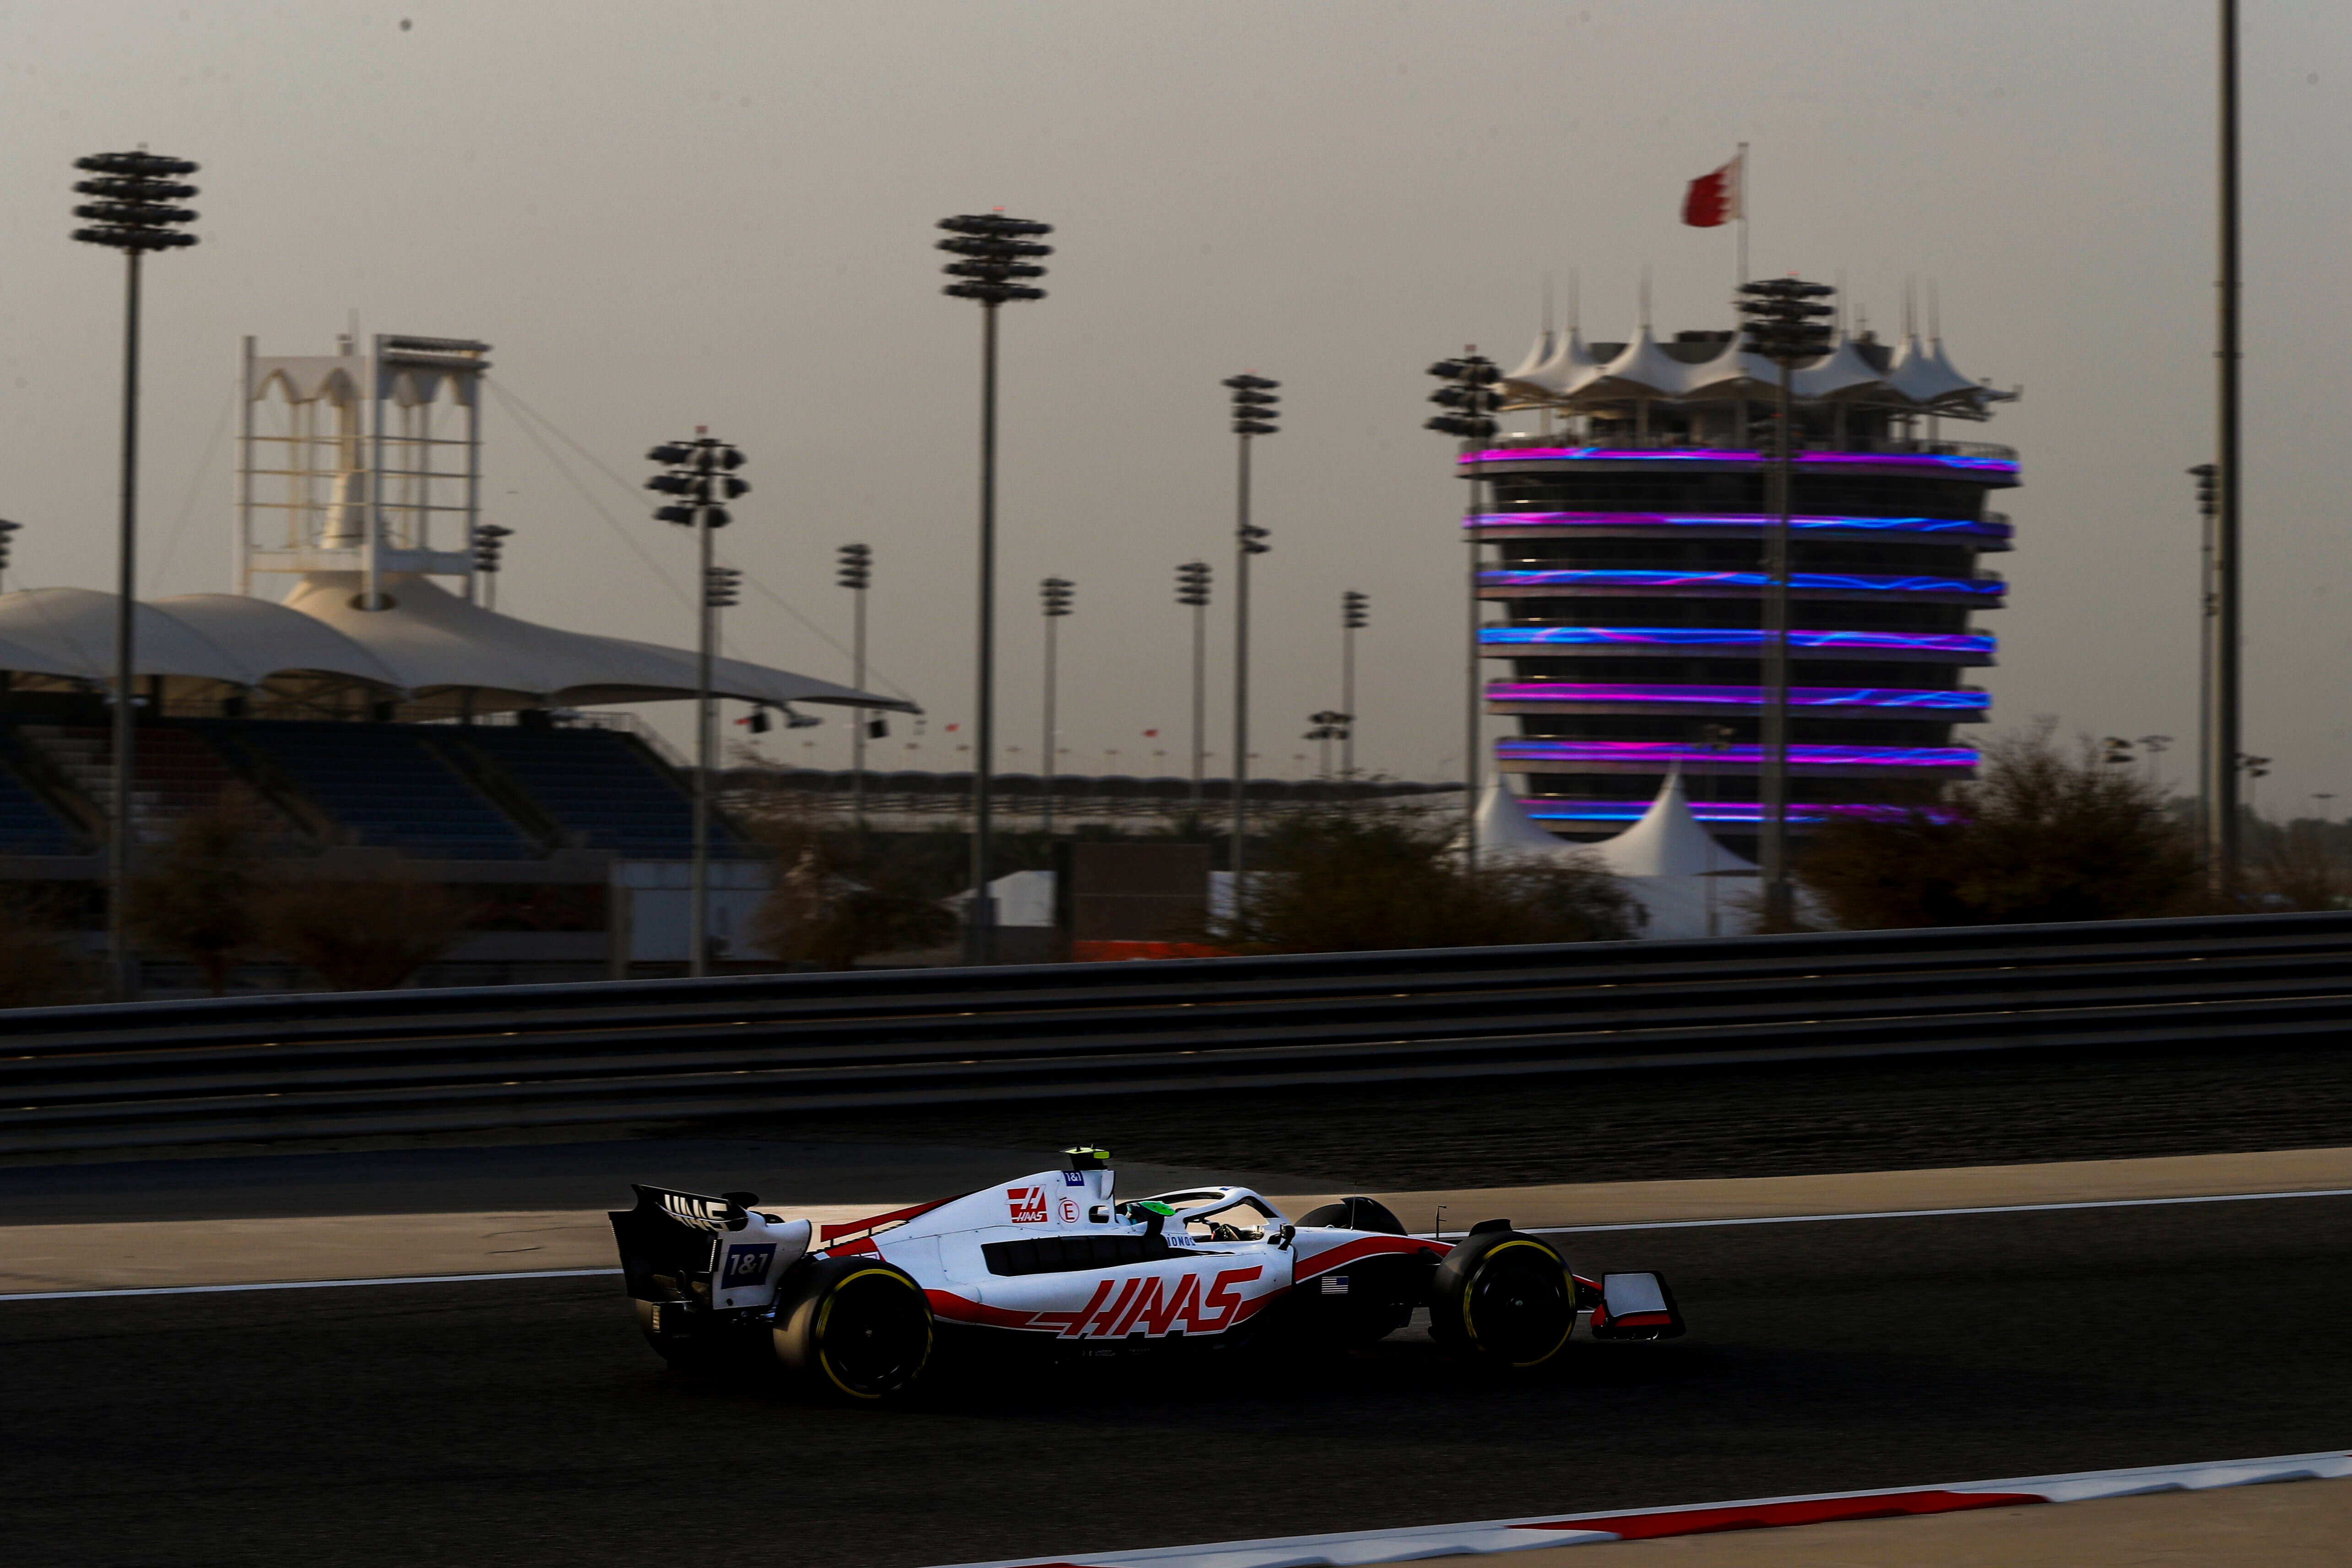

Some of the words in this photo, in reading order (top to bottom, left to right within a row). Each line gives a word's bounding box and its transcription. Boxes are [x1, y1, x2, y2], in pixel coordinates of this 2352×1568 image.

[1065, 1172, 1082, 1182] 1&1
[664, 1194, 731, 1232] HAAS
[1011, 1211, 1047, 1221] HAAS
[1064, 1204, 1075, 1220] E
[1167, 1237, 1196, 1246] IONOS
[729, 1253, 770, 1275] 1&1
[1033, 1265, 1263, 1336] HAAS
